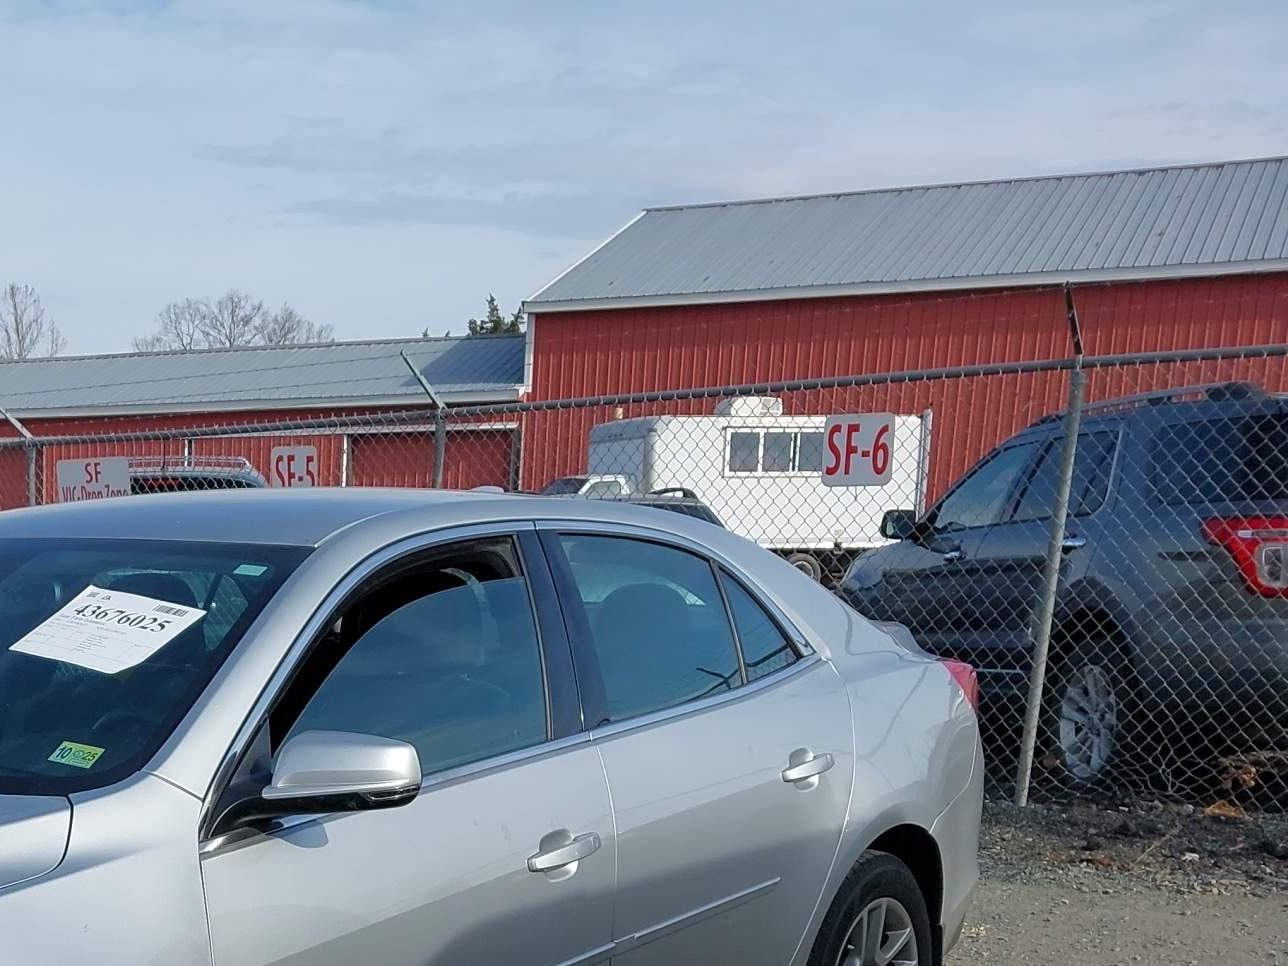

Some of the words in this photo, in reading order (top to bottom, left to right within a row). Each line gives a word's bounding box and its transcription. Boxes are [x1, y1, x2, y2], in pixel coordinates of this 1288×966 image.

[825, 423, 890, 476] SF-6
[85, 462, 102, 484] SF
[275, 454, 316, 487] SF-5
[74, 603, 174, 632] 43676025
[55, 746, 73, 759] 10
[80, 751, 99, 762] 25
